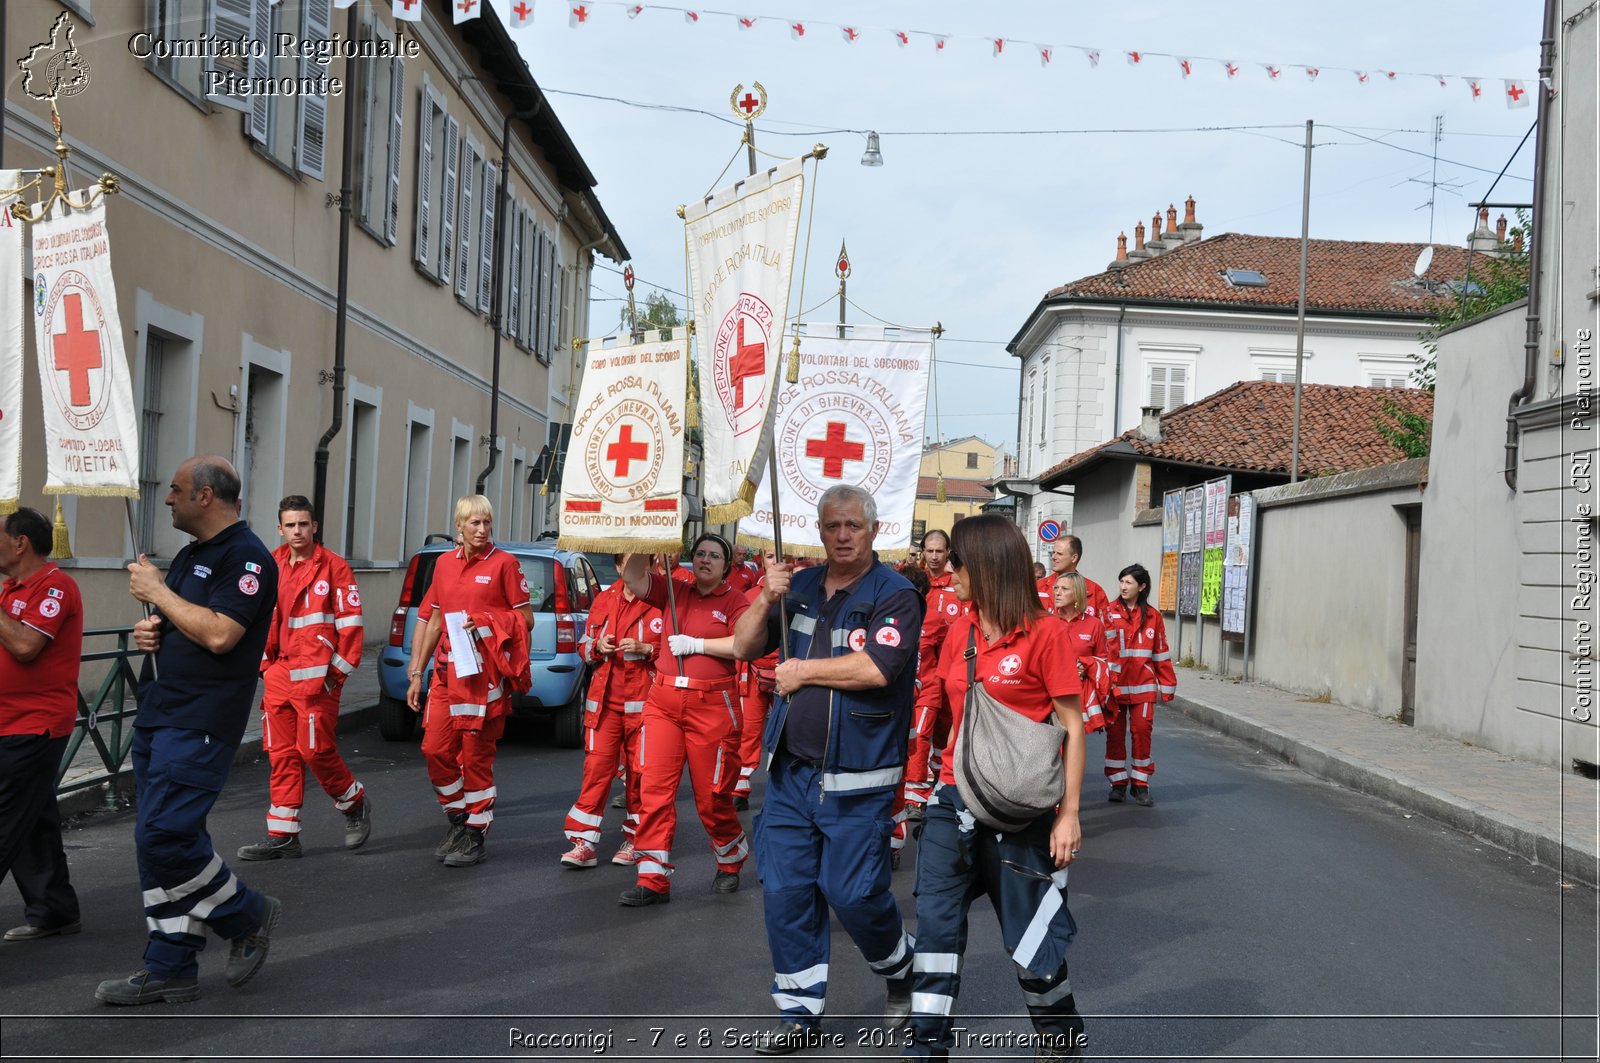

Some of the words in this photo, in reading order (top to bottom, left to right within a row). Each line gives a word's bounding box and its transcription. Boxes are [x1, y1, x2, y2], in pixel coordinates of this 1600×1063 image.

[55, 248, 79, 265] ROSSA
[74, 273, 83, 285] DI
[725, 316, 737, 332] DI
[640, 353, 653, 364] DEL
[800, 353, 848, 368] VOLONTARI
[854, 357, 870, 369] DEL
[873, 357, 920, 371] SOCCORSO
[573, 393, 605, 437] CROCE
[800, 370, 860, 392] ROSSA
[862, 377, 914, 445] ITALIANA
[800, 402, 815, 418] DI
[818, 394, 873, 421] GINEVRA
[871, 420, 886, 437] 22
[587, 426, 613, 498] CONVENZIONE
[605, 412, 616, 426] DI
[782, 418, 818, 501] CONVENZIONE
[868, 440, 889, 486] AGOSTO
[564, 514, 612, 526] COMITATO
[614, 516, 626, 527] DI
[988, 675, 1000, 683] 15
